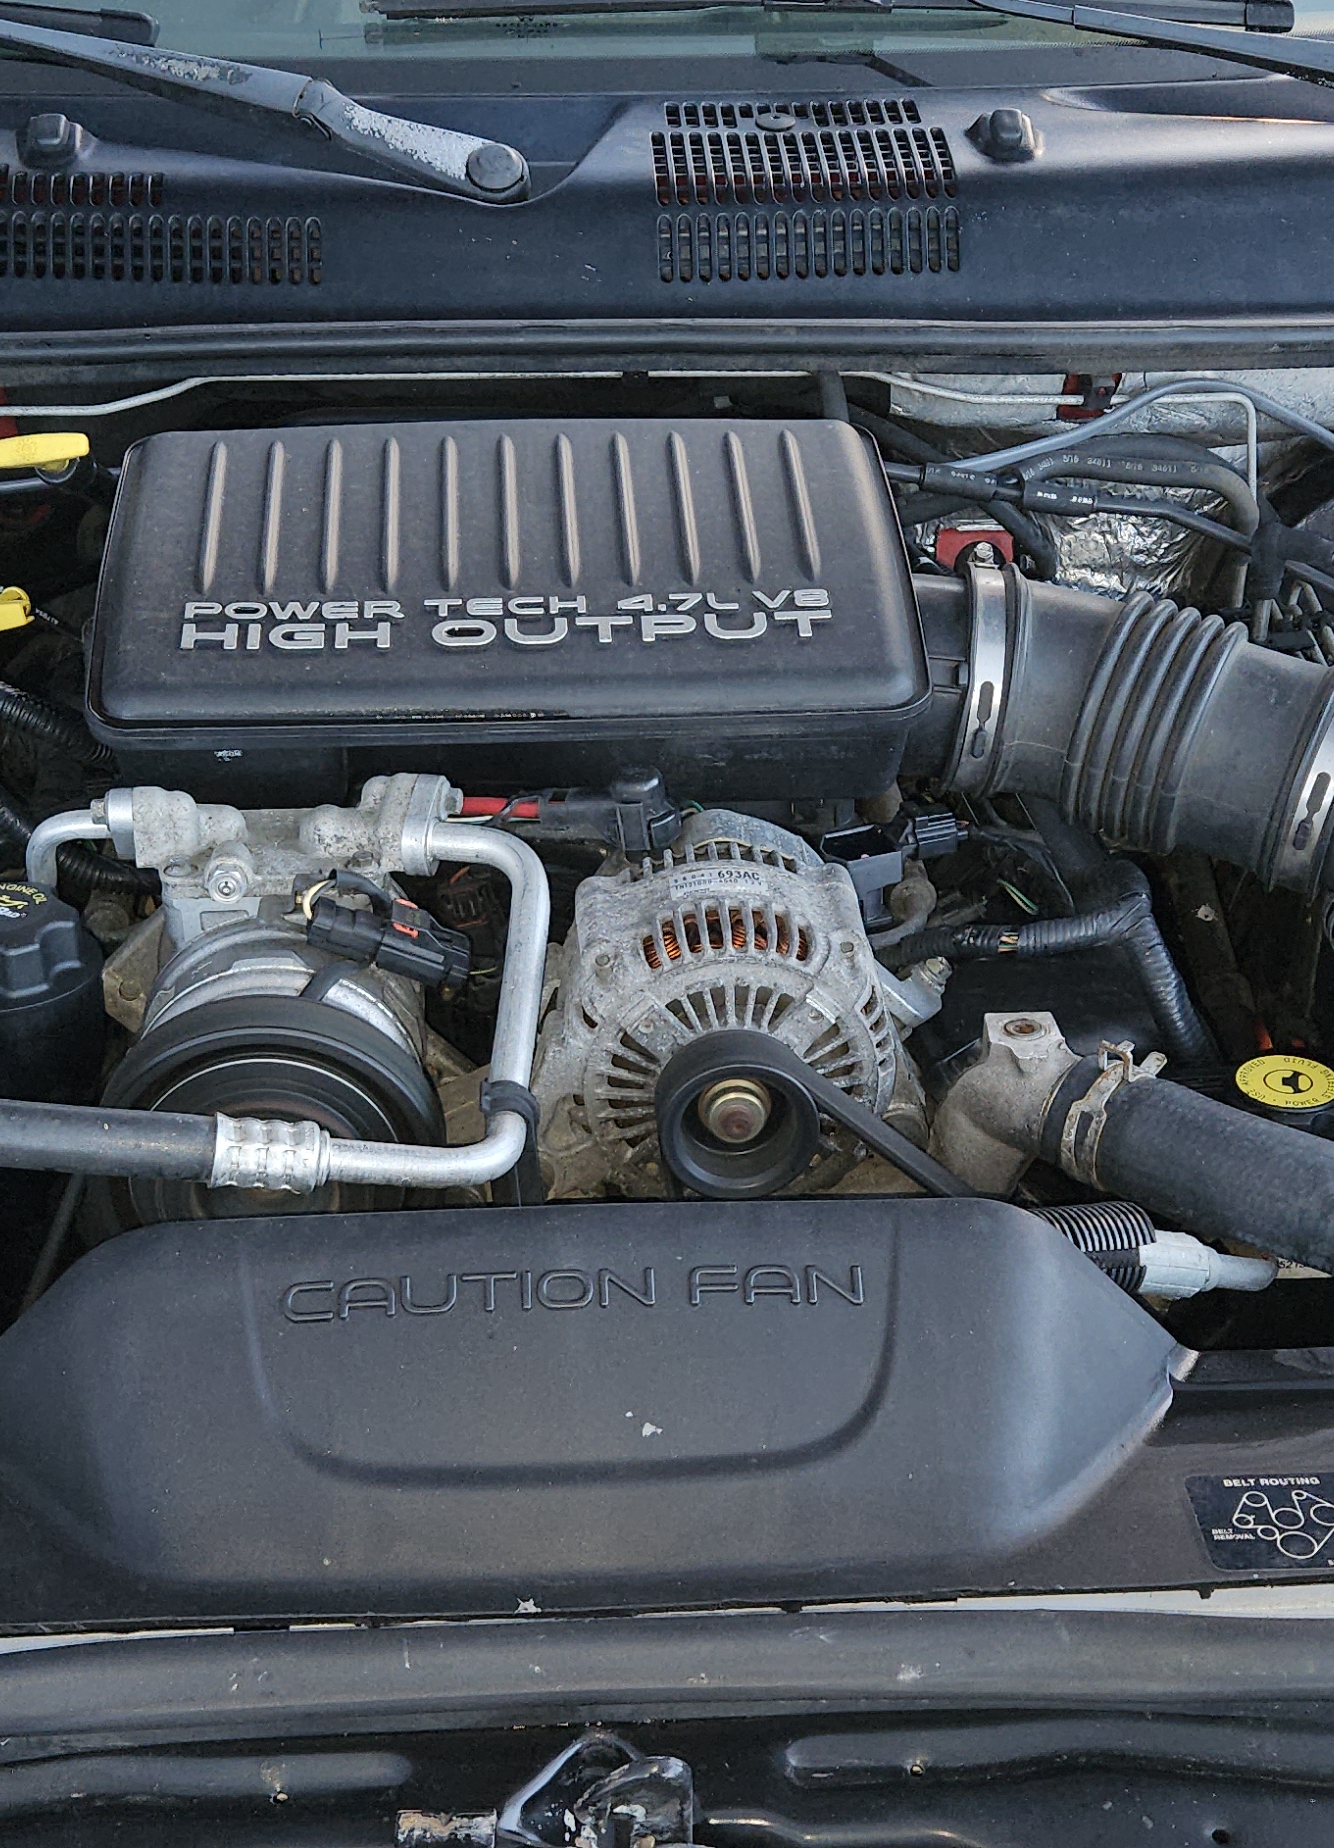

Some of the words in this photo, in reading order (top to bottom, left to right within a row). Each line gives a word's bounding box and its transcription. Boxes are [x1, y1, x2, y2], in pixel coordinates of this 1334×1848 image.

[183, 600, 406, 620] POWER
[423, 595, 588, 617] TECH
[617, 592, 740, 612] 4.7L
[751, 588, 831, 609] V8
[180, 622, 392, 650] HIGH
[431, 609, 833, 646] OUTPUT
[717, 870, 760, 881] 693AC
[32, 892, 48, 905] OIL
[1283, 1057, 1319, 1069] FLUID
[1246, 1088, 1266, 1101] USE
[1284, 1097, 1321, 1107] POWER
[279, 1266, 658, 1324] CAUTION
[688, 1263, 867, 1307] FAN
[1222, 1478, 1256, 1488] BELT
[1259, 1476, 1322, 1487] ROUTING
